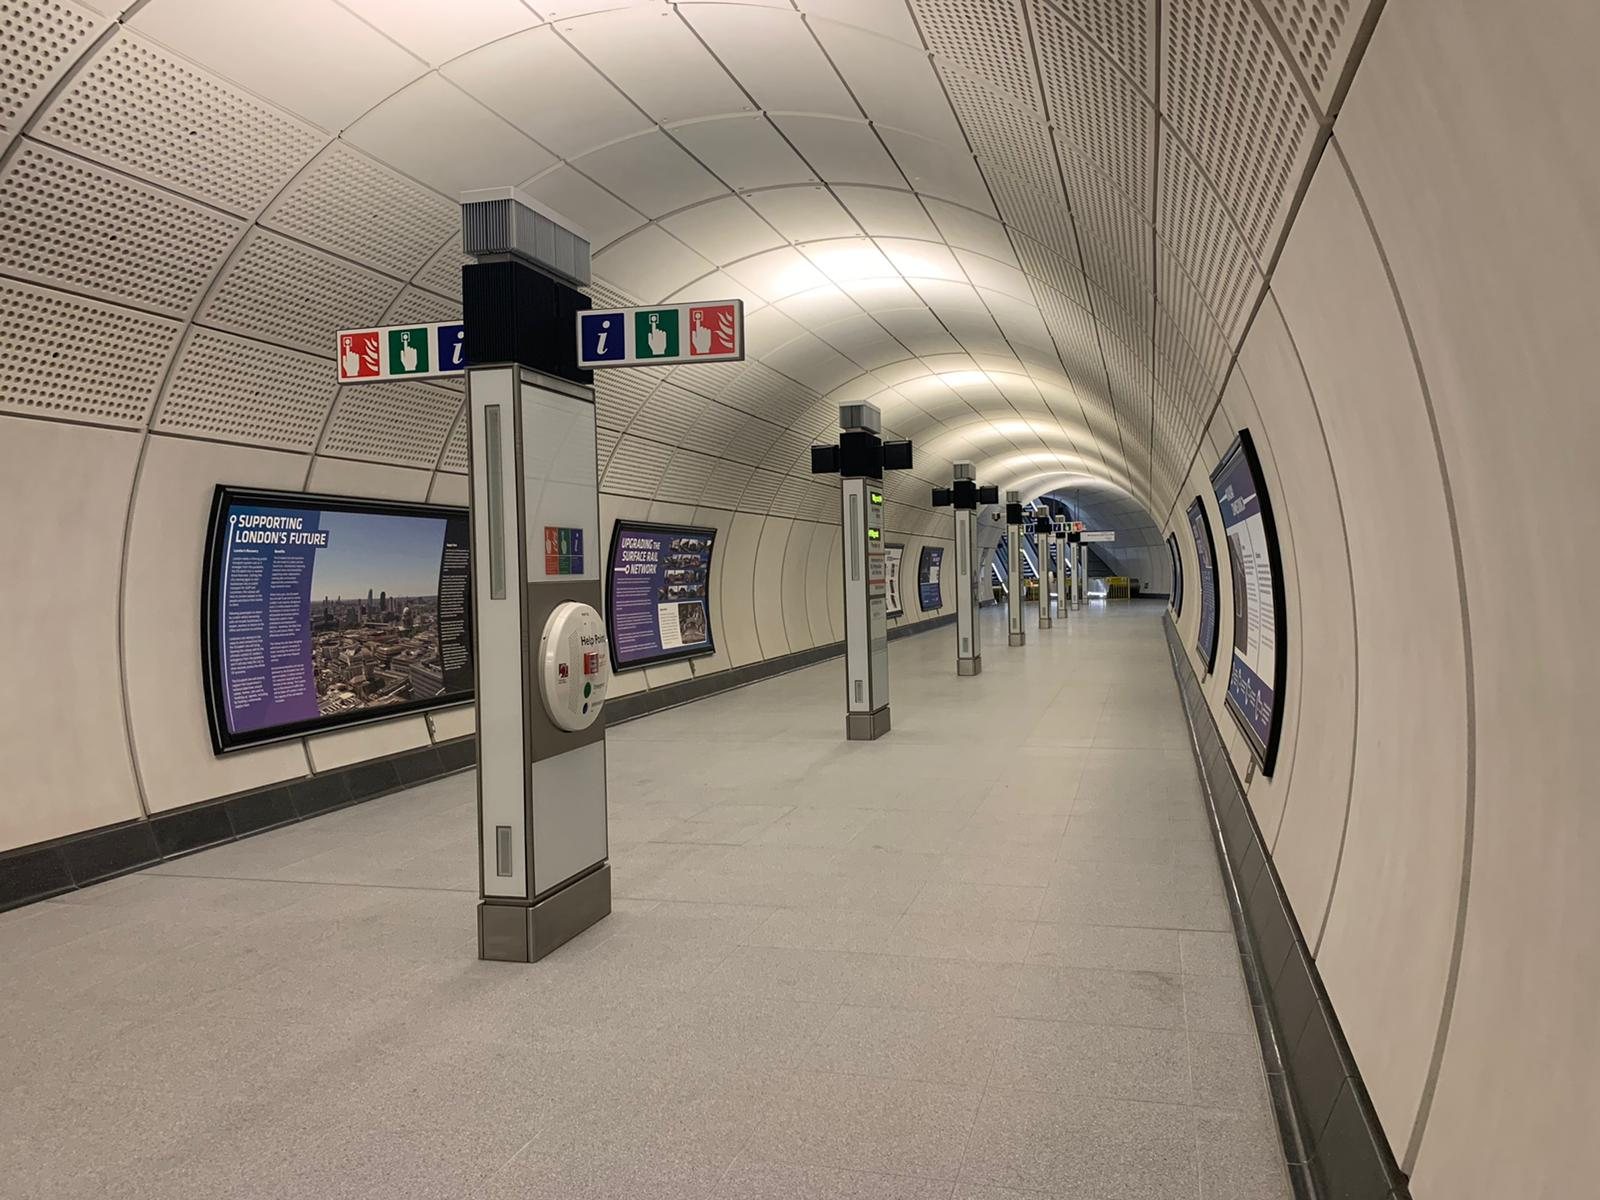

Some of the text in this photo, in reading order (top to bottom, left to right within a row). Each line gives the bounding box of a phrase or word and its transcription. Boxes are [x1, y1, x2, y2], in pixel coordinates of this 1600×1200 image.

[238, 515, 303, 530] SUPPORTING
[235, 531, 326, 545] LONDON'S FUTURE
[622, 538, 661, 550] UPGRADING THE
[622, 551, 658, 561] SURFACE RAIL
[630, 564, 657, 574] NETWORK
[580, 636, 594, 646] Help
